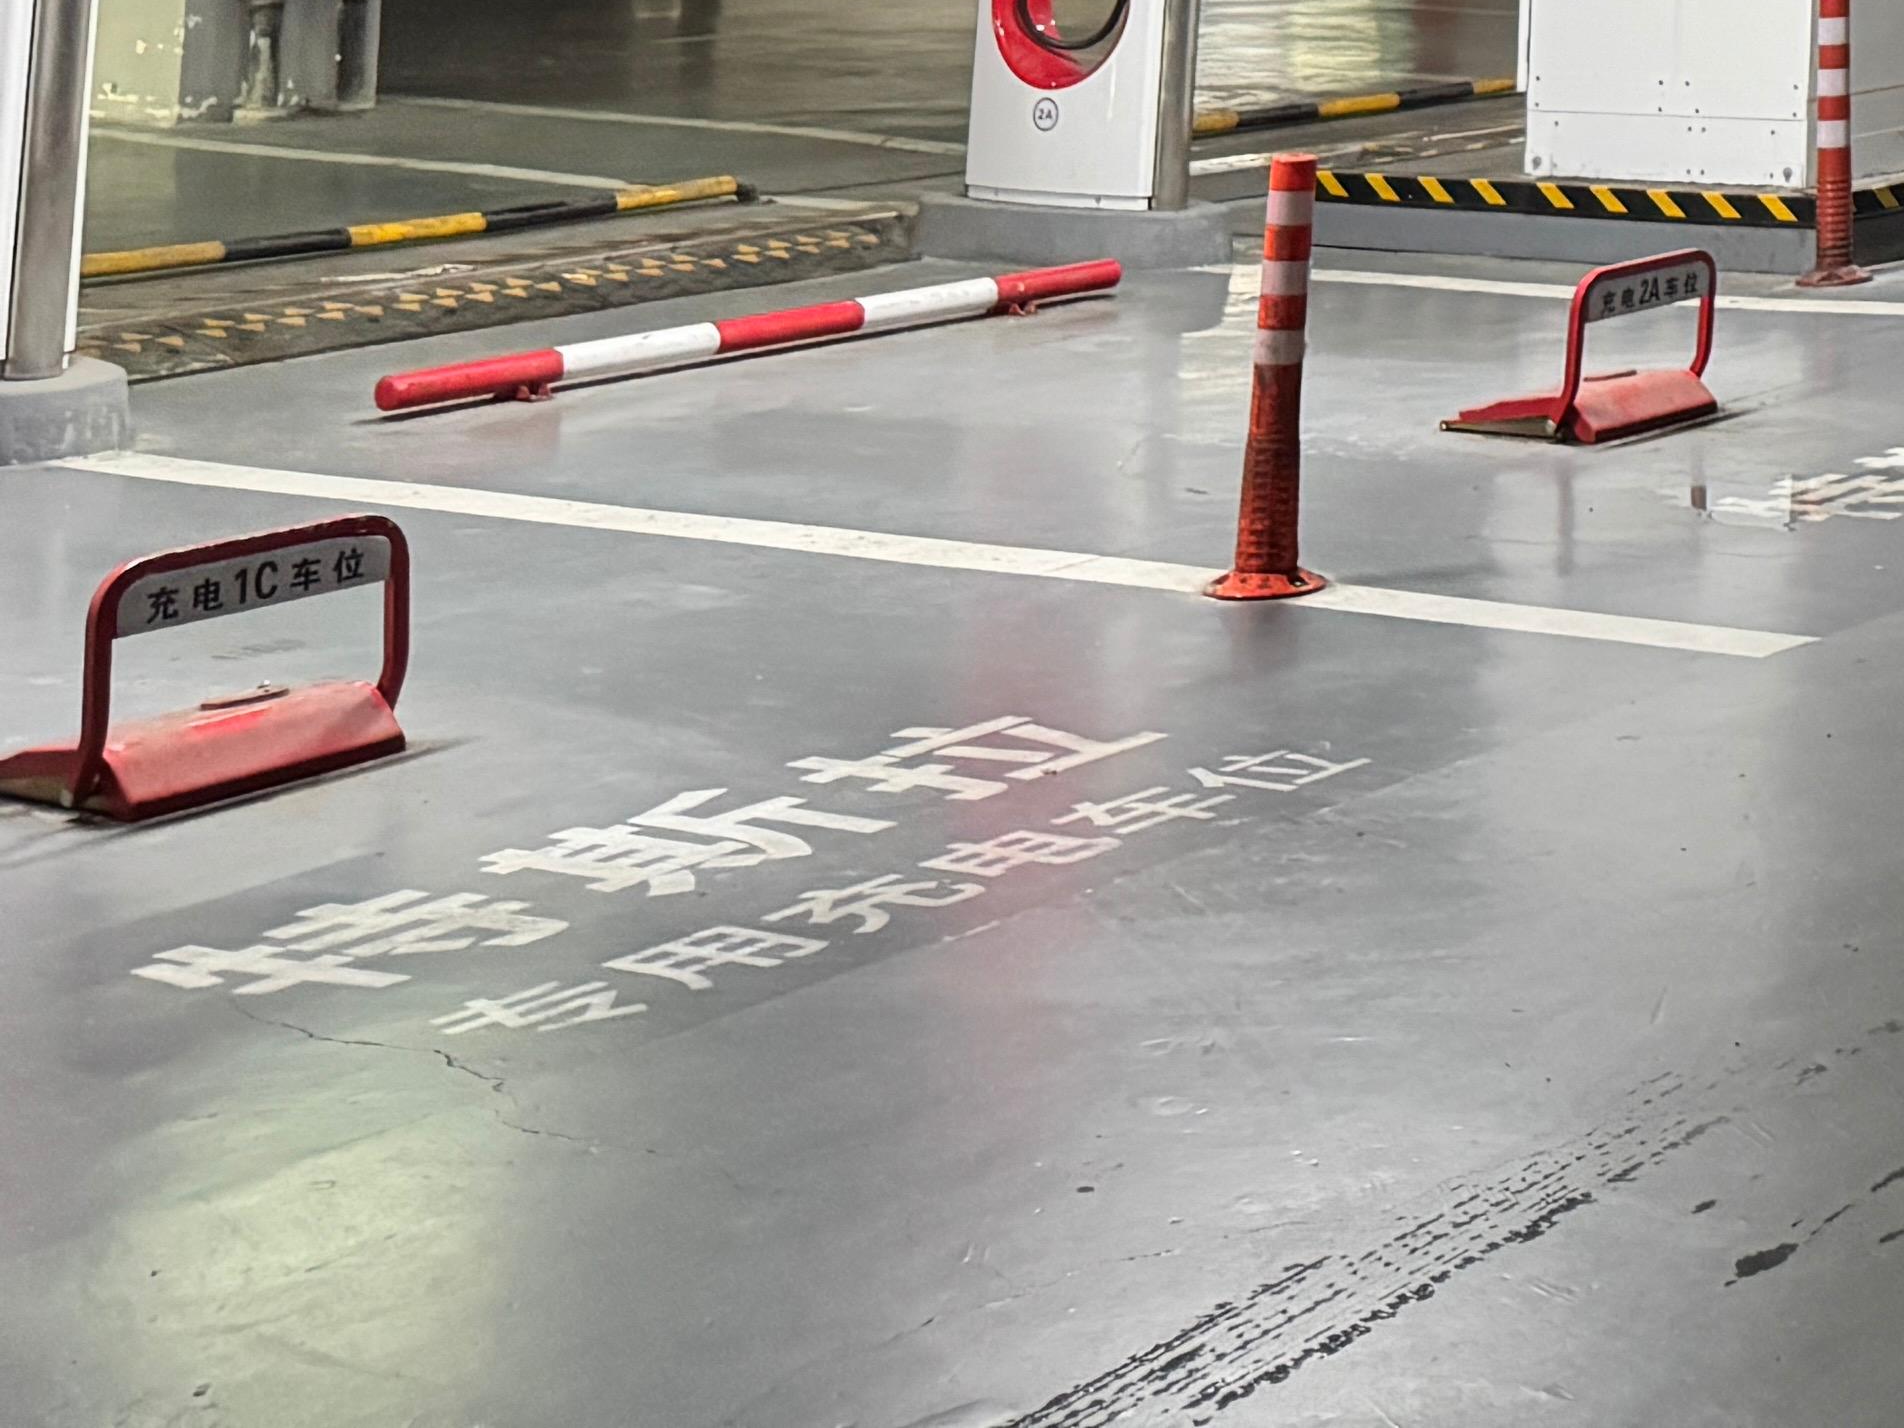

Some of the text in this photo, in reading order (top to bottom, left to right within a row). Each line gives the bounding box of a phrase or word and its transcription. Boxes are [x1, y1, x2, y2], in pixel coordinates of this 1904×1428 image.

[1037, 107, 1053, 121] 2A
[146, 547, 366, 624] 充电1C车位
[131, 715, 1168, 995] 特斯拉
[430, 745, 1373, 1035] 专用充电车位
